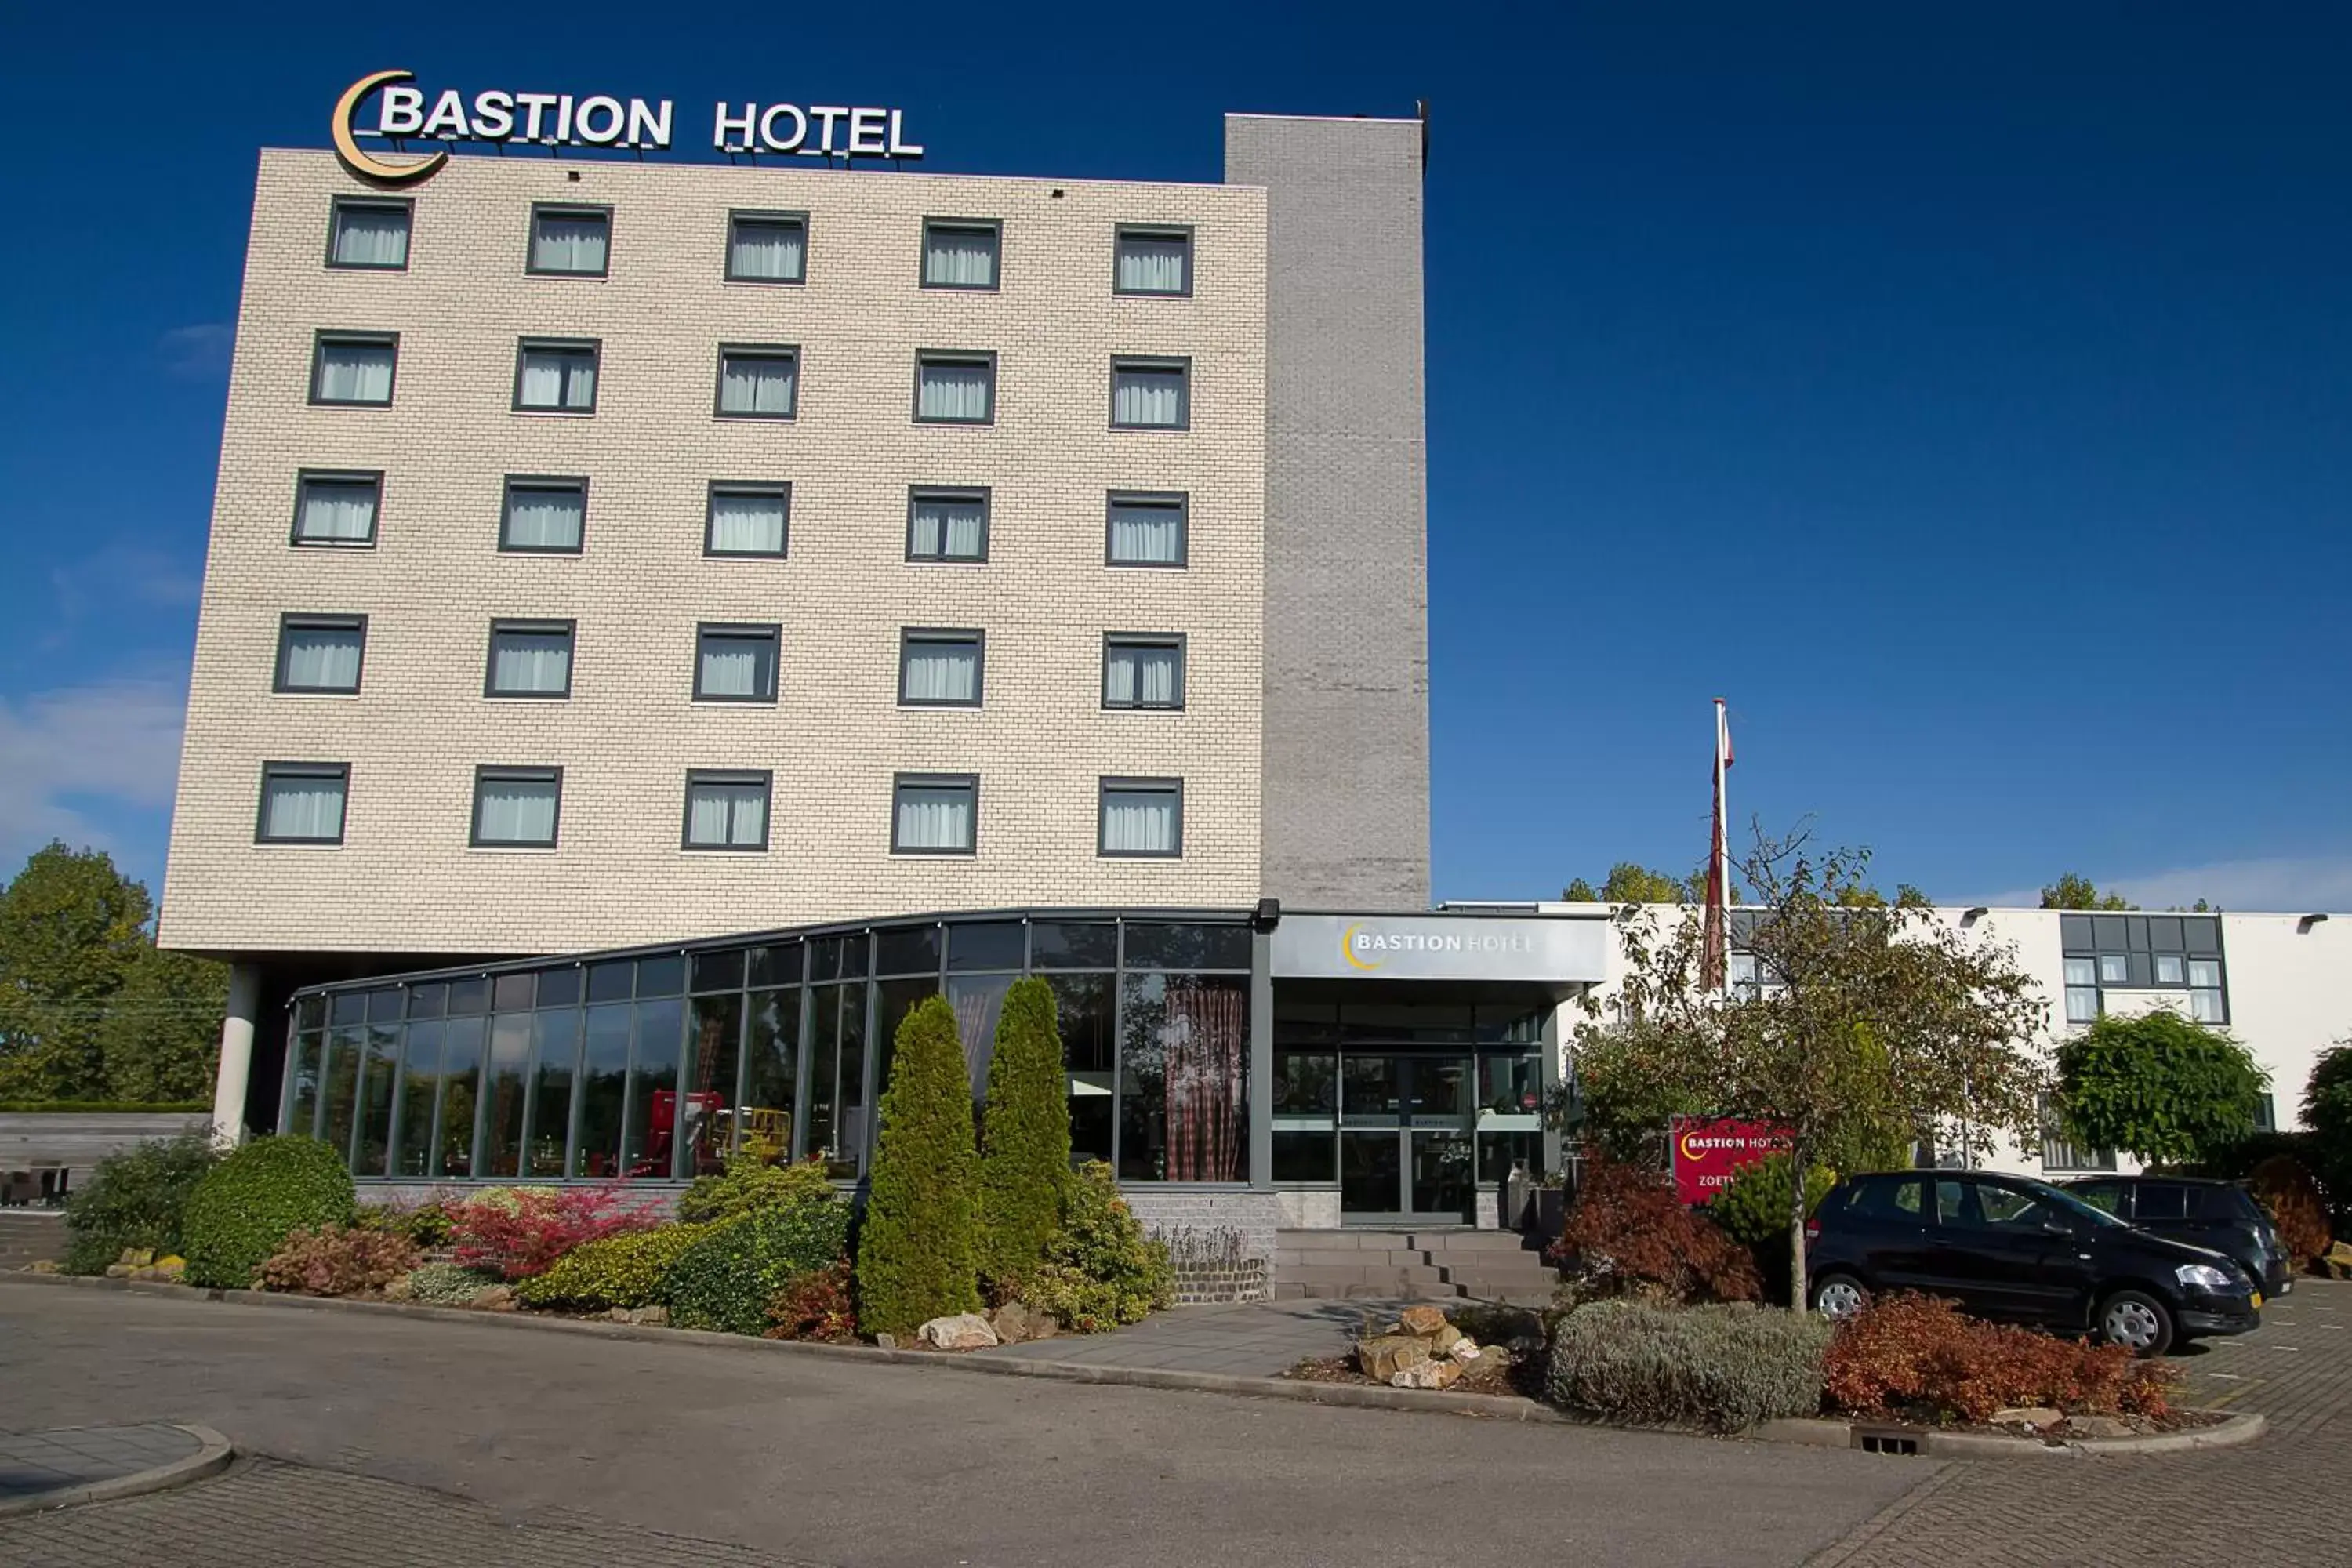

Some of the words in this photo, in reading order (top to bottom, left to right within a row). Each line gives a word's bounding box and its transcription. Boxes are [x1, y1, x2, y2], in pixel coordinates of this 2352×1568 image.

[379, 85, 674, 147] BASTION
[713, 101, 925, 154] HOTEL
[1356, 933, 1461, 952] BASTION
[1468, 934, 1536, 953] HOTEL
[1687, 1138, 1744, 1149] BASTION
